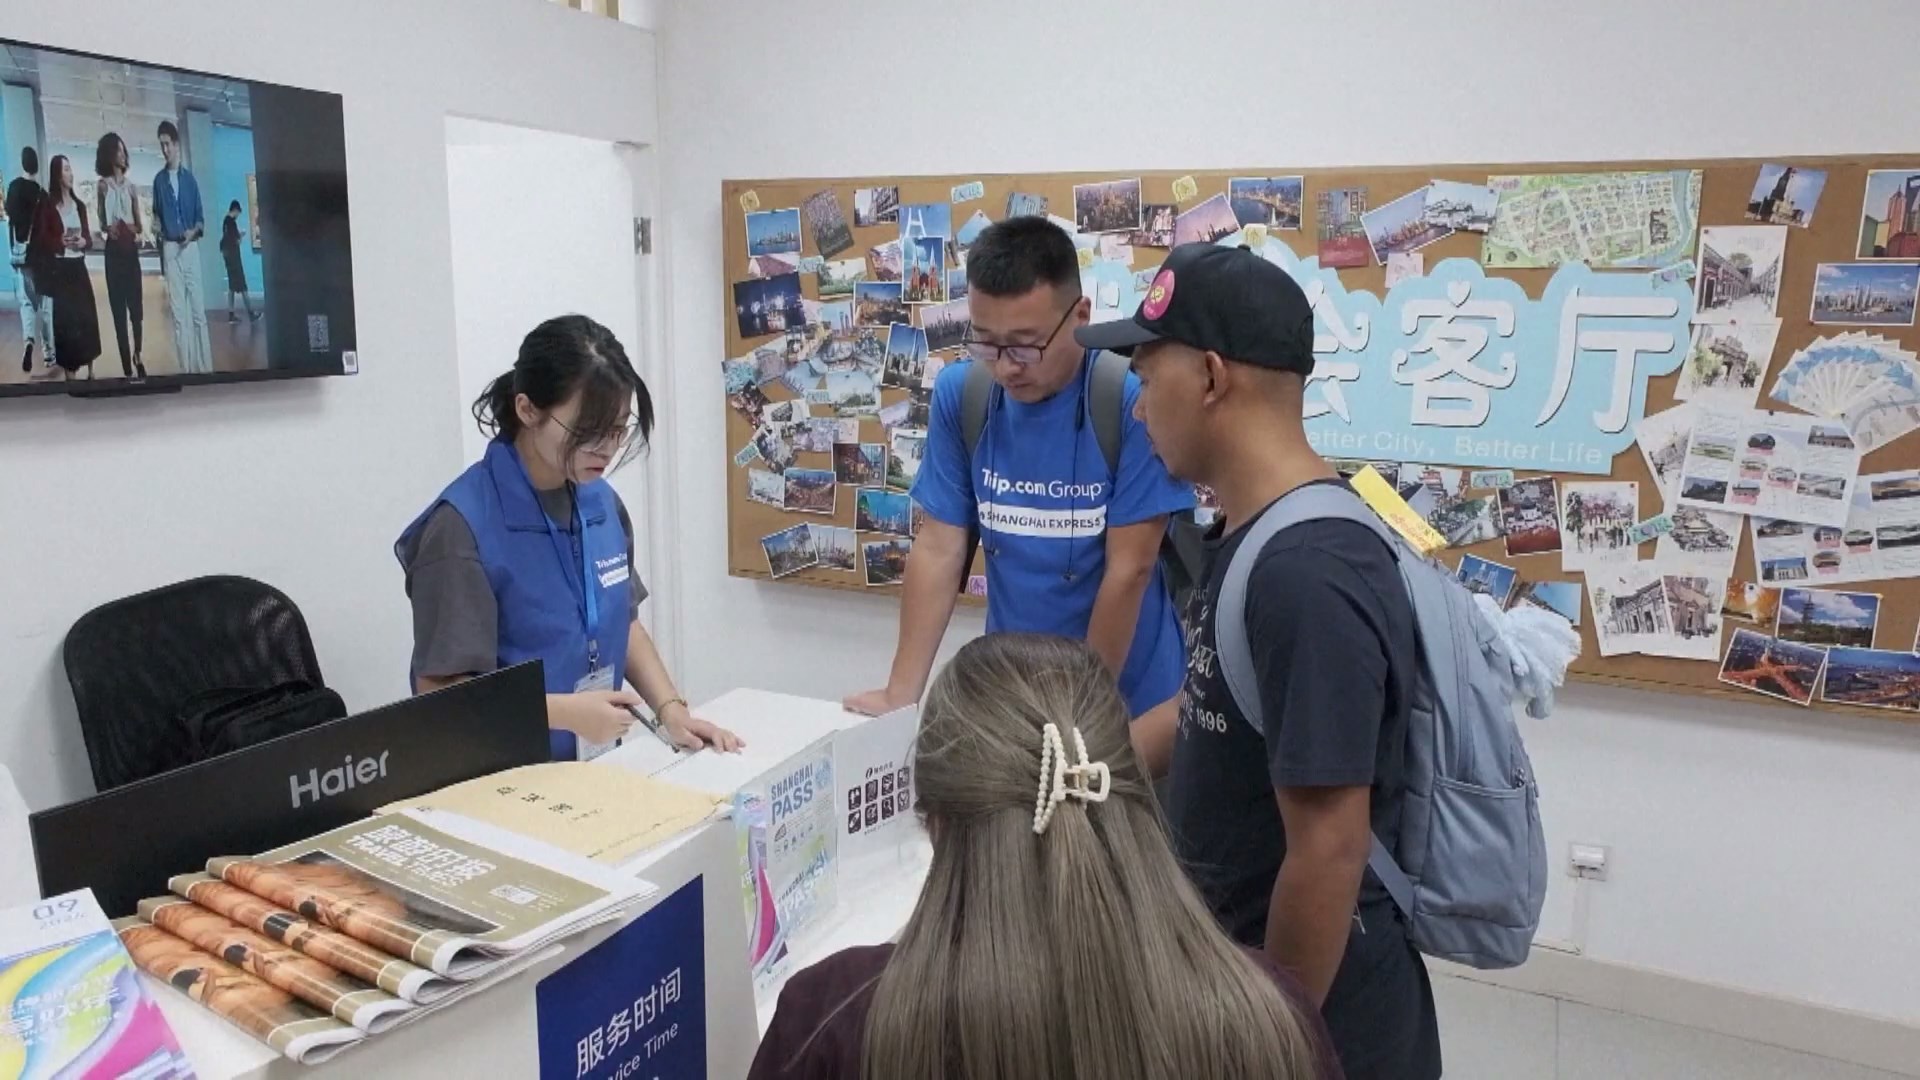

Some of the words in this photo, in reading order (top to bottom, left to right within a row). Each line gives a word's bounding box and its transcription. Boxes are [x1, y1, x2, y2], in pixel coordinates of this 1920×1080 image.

[1306, 430, 1366, 450] etter
[1454, 435, 1540, 462] Better
[1549, 440, 1604, 465] Life
[1048, 480, 1102, 501] Group
[987, 511, 1046, 529] SHANGHAI
[1048, 516, 1101, 529] EXPRESS
[1196, 707, 1227, 733] 1996
[289, 749, 390, 809] Haier
[771, 762, 813, 801] SHANGHAI
[772, 779, 814, 826] PASS
[577, 967, 681, 1079] 服务时间
[643, 1023, 679, 1059] Time
